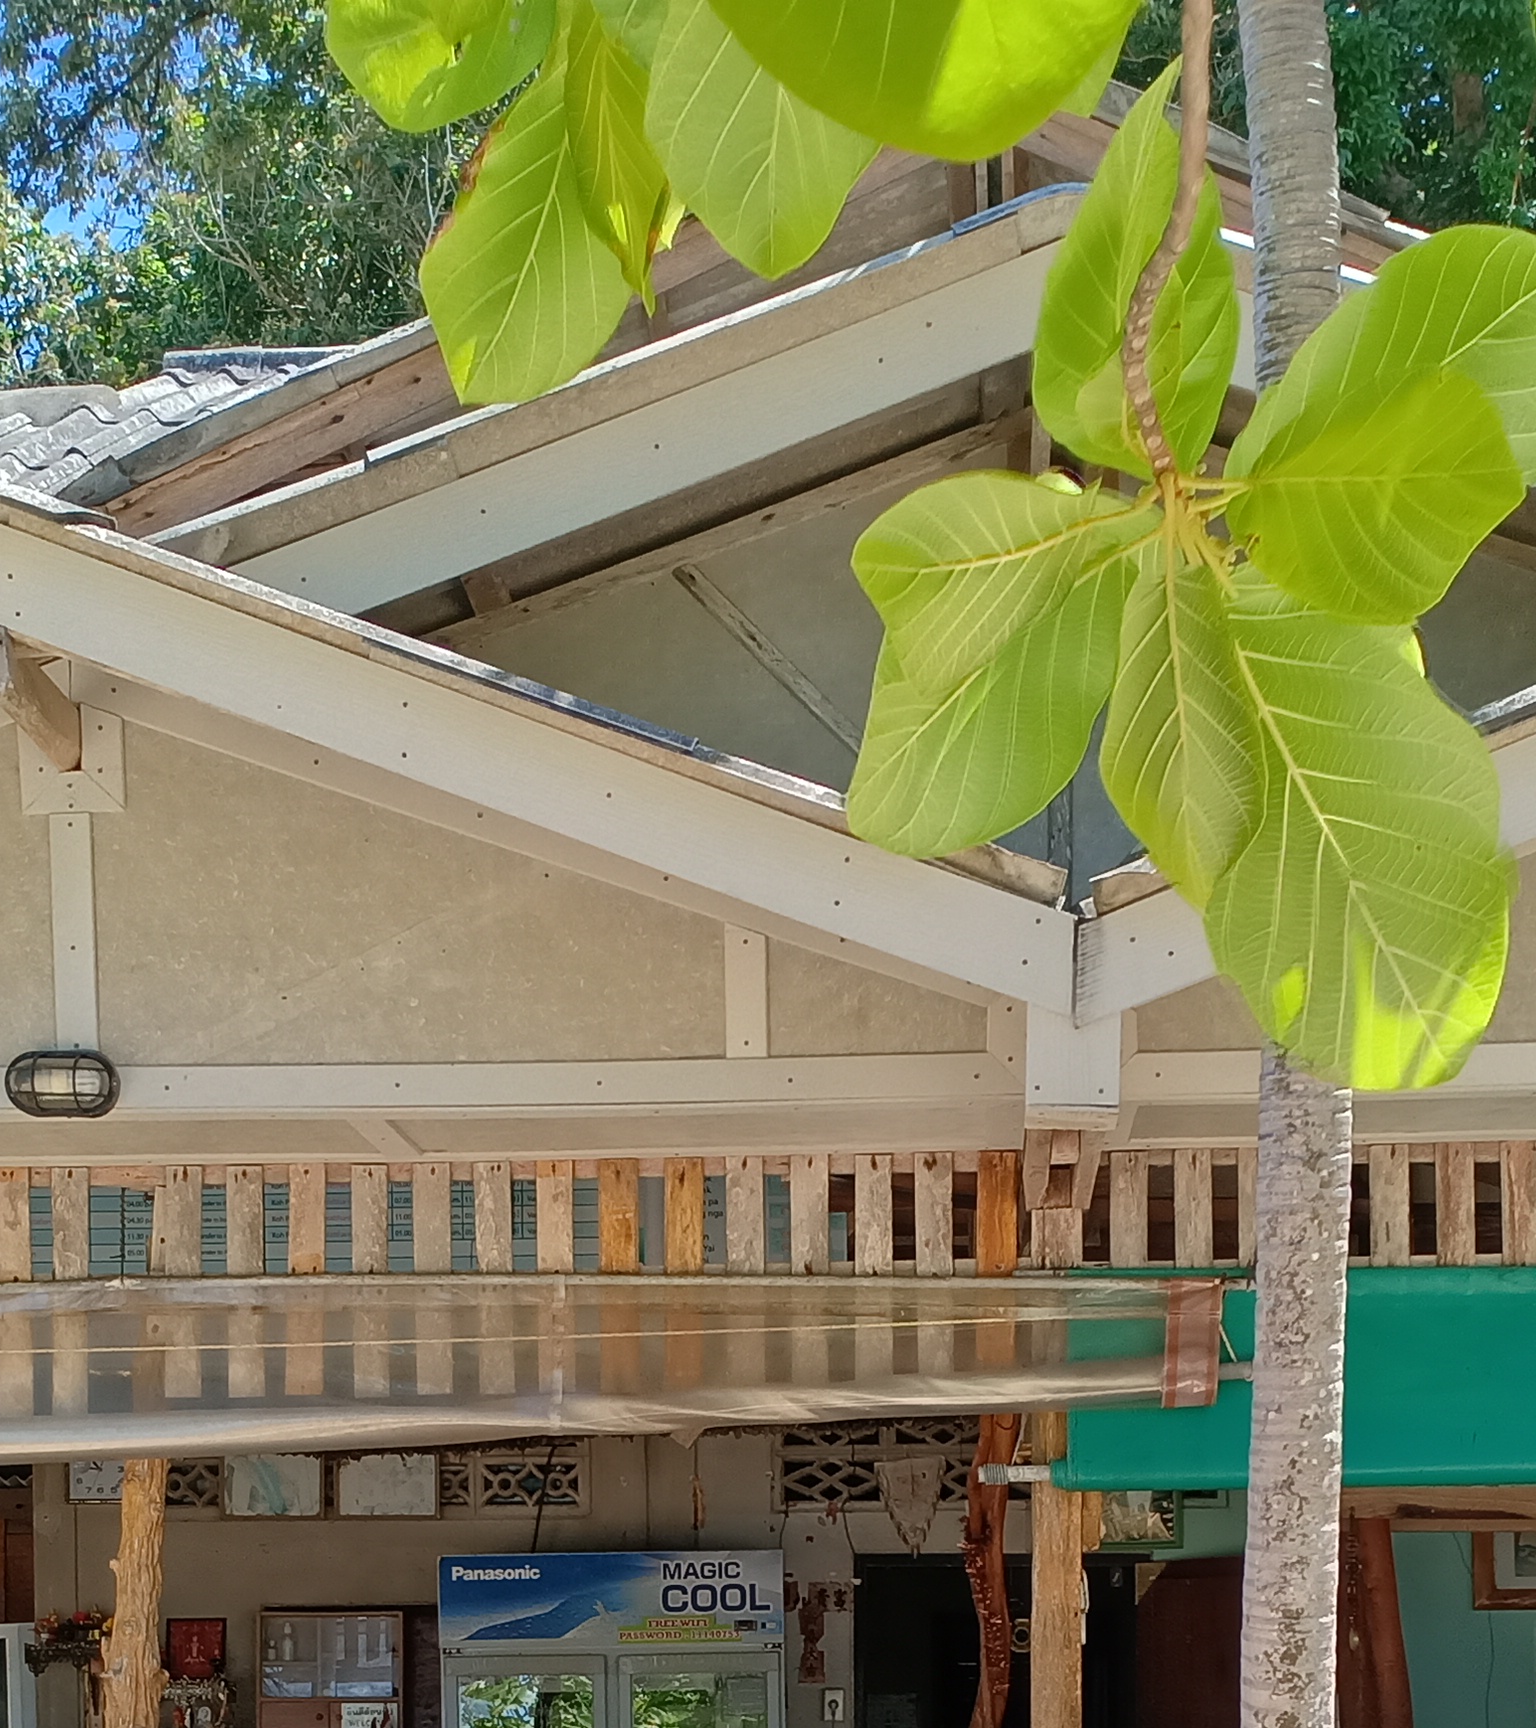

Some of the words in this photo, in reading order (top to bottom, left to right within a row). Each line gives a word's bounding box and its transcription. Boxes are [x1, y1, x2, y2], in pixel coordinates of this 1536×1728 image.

[451, 1565, 541, 1582] Panasonic
[662, 1561, 741, 1580] MAGIC
[661, 1583, 772, 1613] COOL
[648, 1619, 679, 1628] FREE
[619, 1631, 682, 1640] PASSWORD
